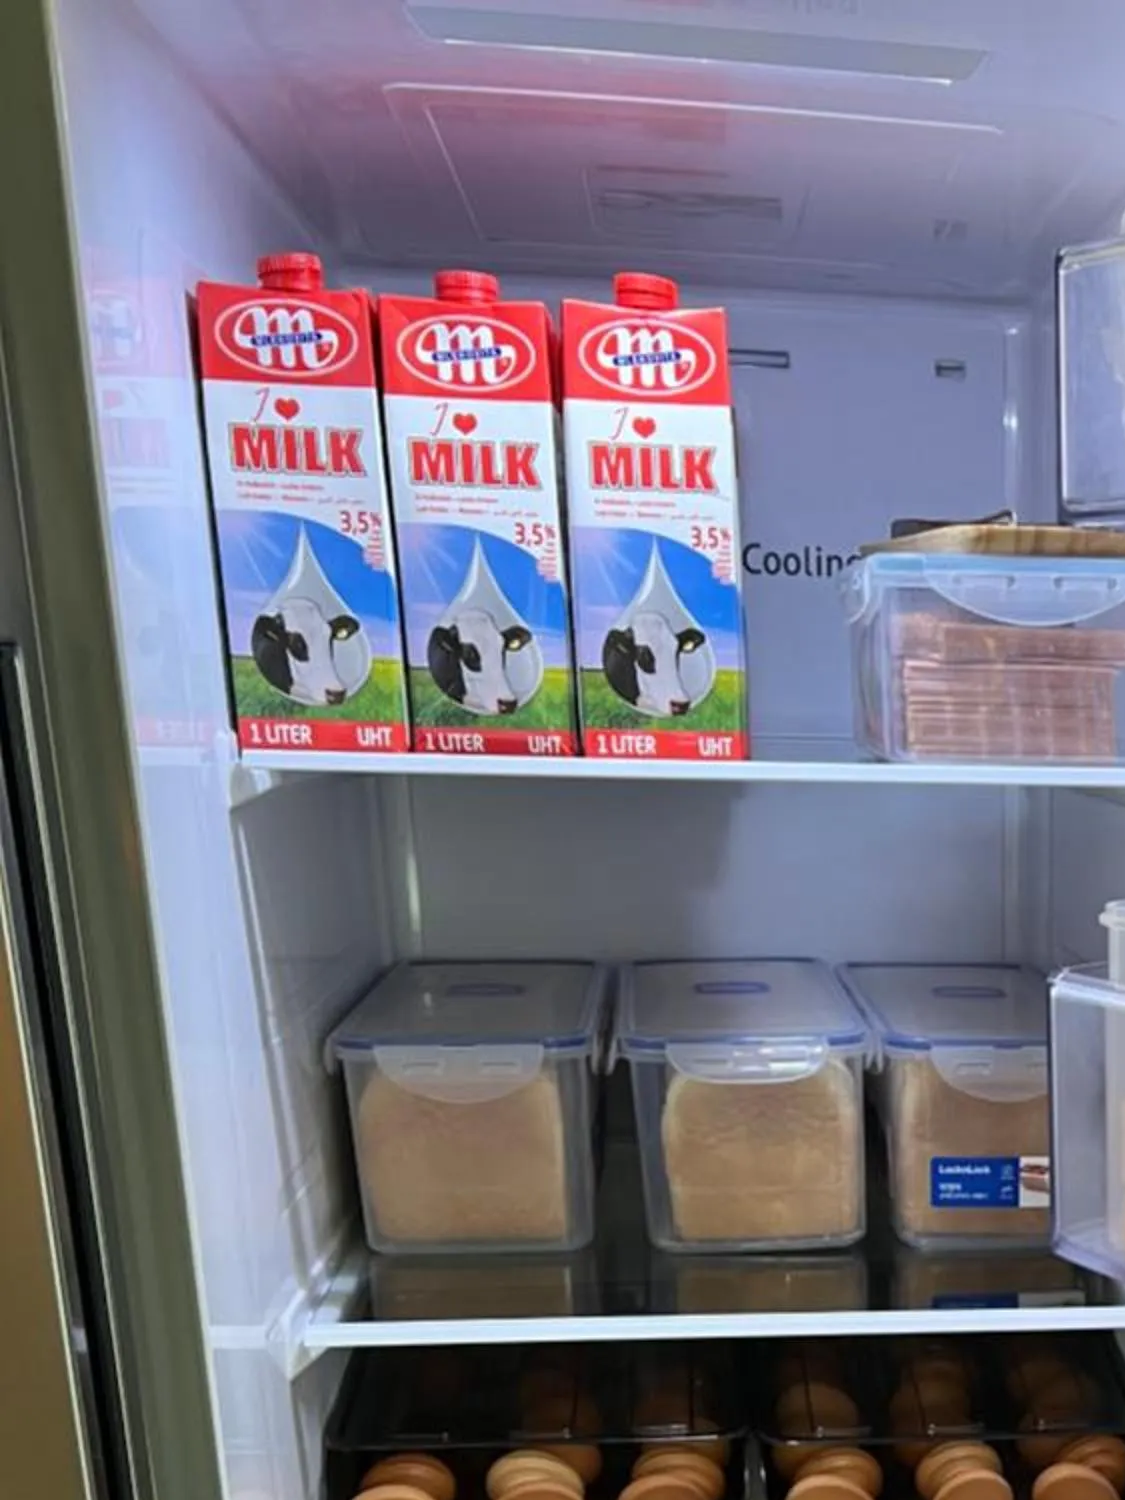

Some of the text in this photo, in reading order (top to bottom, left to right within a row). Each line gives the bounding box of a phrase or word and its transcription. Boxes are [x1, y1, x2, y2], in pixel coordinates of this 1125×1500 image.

[231, 424, 366, 476] MILK
[408, 436, 543, 490] MILK
[588, 440, 721, 494] MILK
[250, 724, 312, 744] 1 LITER
[357, 727, 393, 747] UHT
[425, 733, 485, 752] 1 LITER
[528, 735, 561, 754] UHT
[597, 735, 656, 755] 1 LITER
[697, 737, 733, 756] UHT
